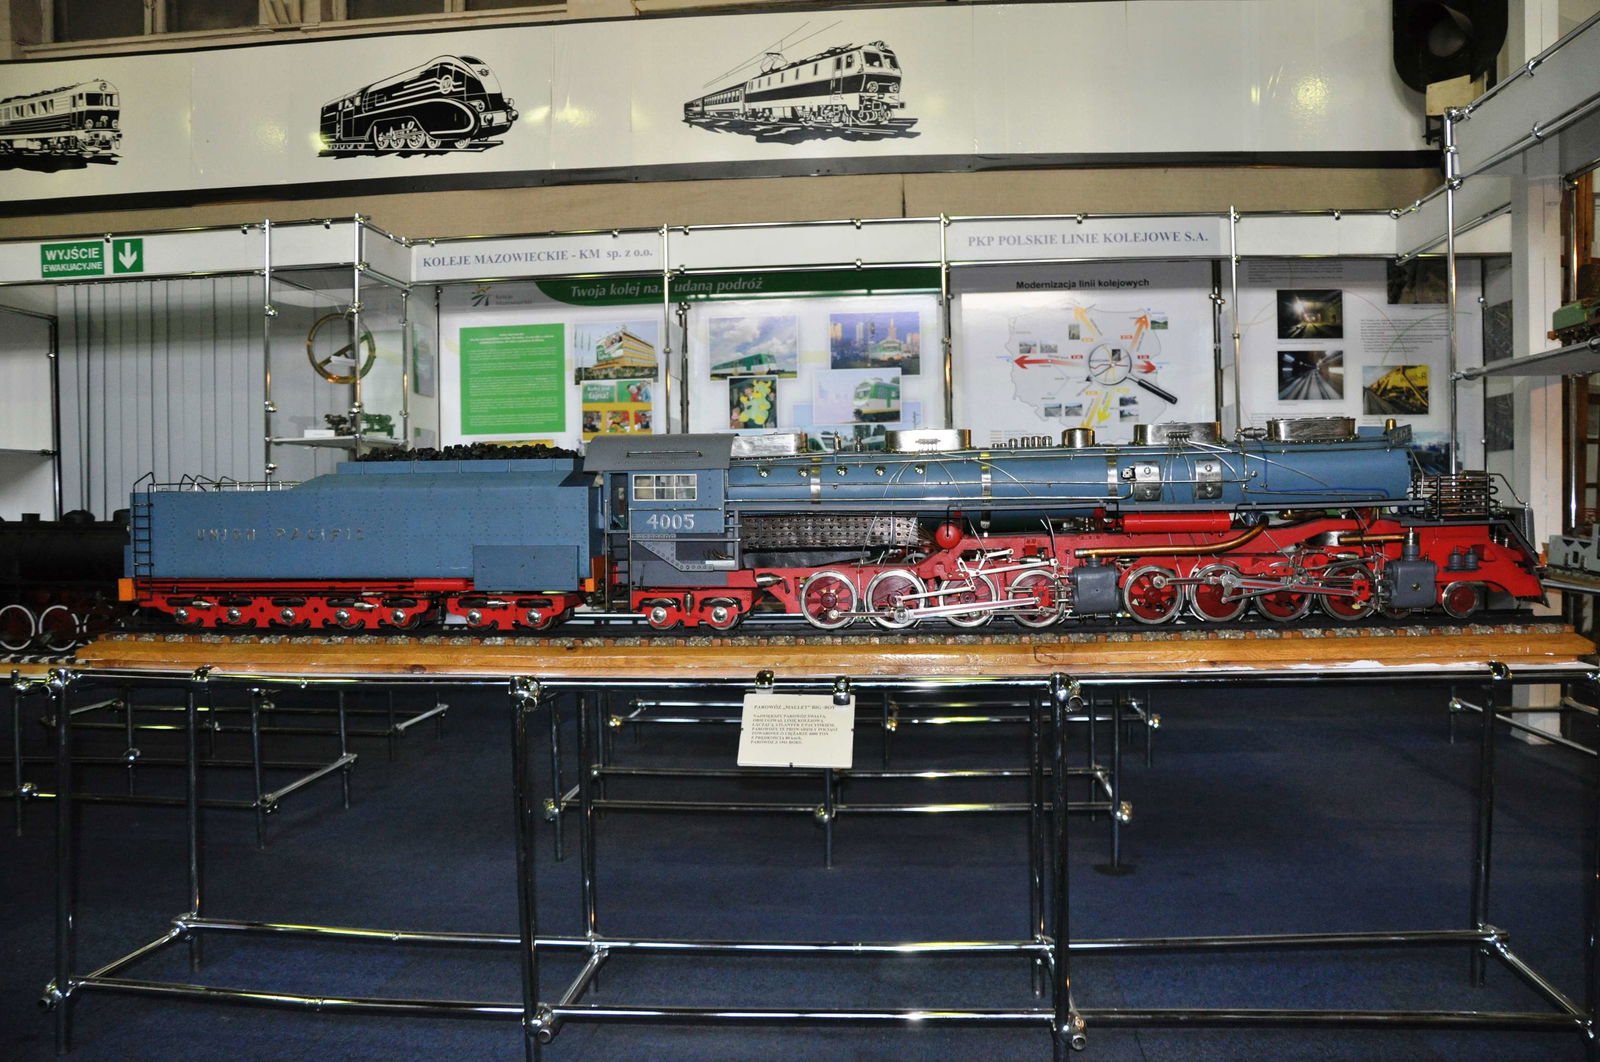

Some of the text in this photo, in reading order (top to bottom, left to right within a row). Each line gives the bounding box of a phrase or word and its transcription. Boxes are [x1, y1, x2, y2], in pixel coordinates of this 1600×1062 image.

[968, 231, 1209, 247] PKP POLSKIE LINIE KOLEJOWE S.A.
[45, 246, 100, 261] WYJŚCIE
[422, 256, 471, 268] KOLEJE
[475, 250, 569, 266] MAZOWIECKIE
[579, 249, 600, 259] KM
[606, 250, 622, 260] sp.
[633, 249, 653, 257] o.o.
[43, 261, 103, 273] EWAKUACYJNE
[571, 286, 606, 298] Twoja
[610, 282, 641, 296] kolej
[674, 280, 712, 293] udaną
[717, 277, 763, 294] podróż
[1016, 278, 1150, 290] Modernizacja linii kolejowych
[646, 513, 695, 530] 4005
[275, 528, 365, 541] PACIFIC
